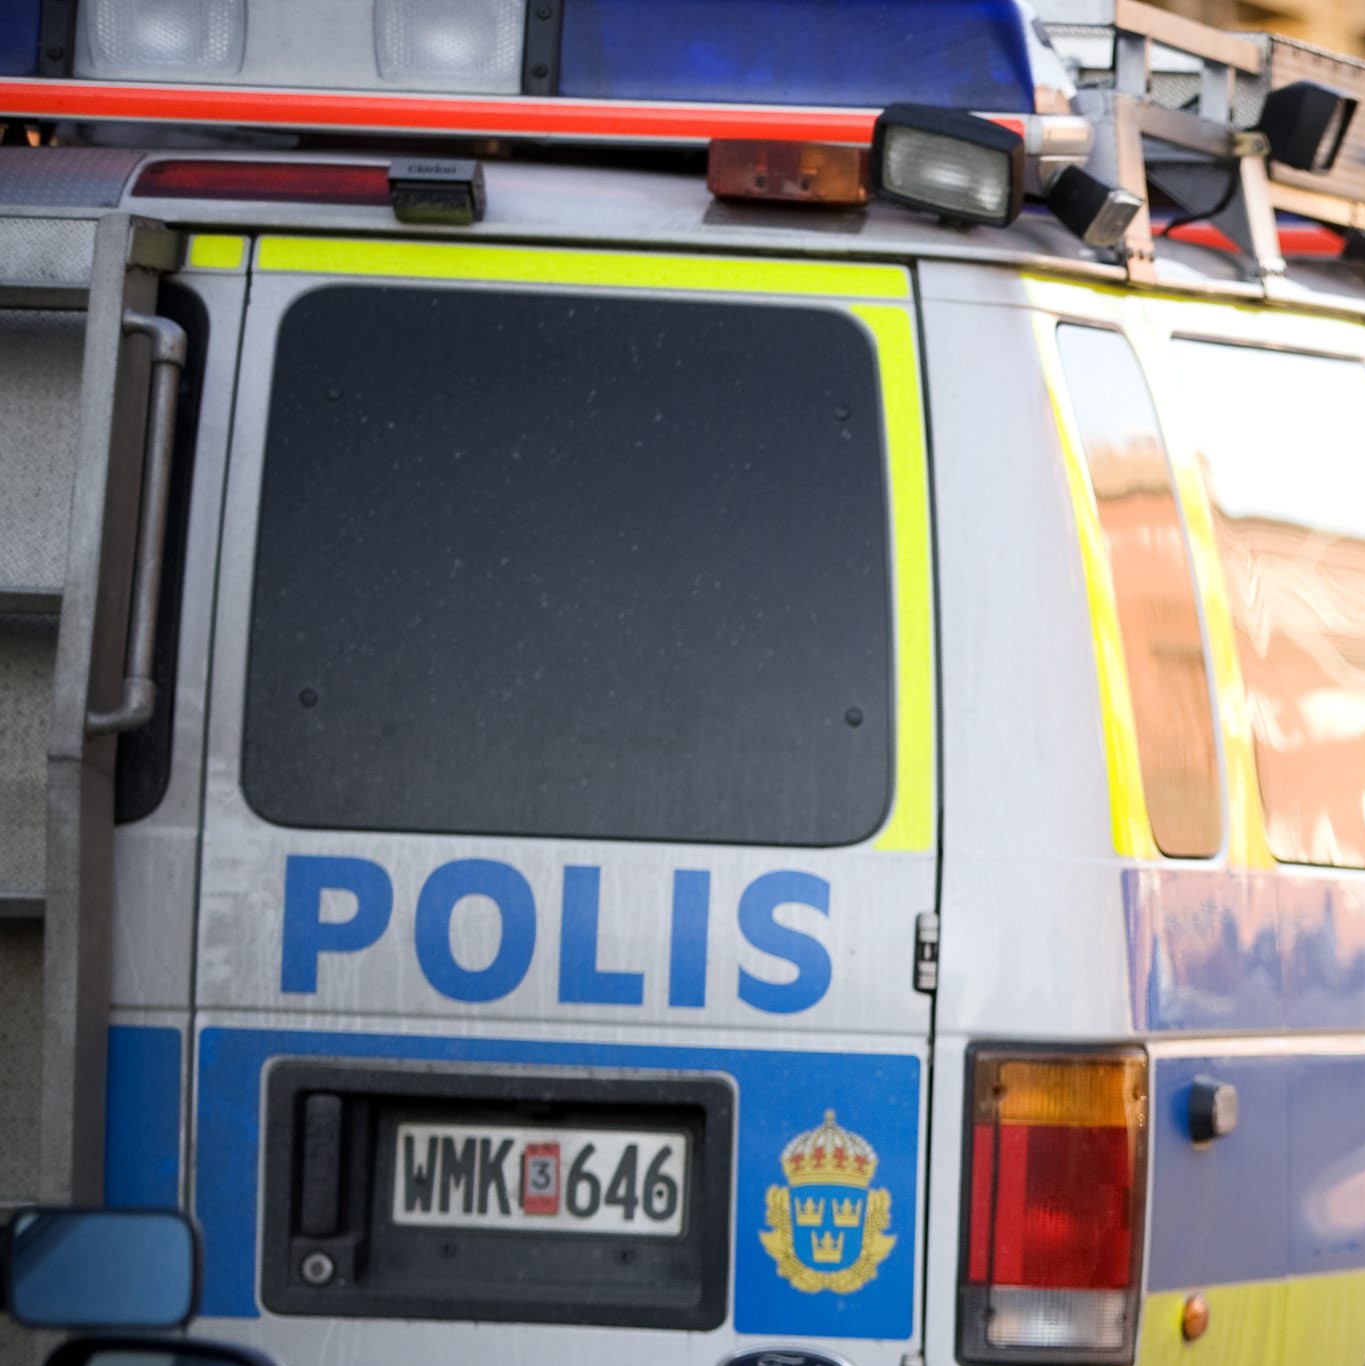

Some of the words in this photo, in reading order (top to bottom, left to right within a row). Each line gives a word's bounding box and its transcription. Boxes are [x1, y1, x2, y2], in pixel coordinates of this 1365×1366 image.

[280, 855, 833, 1014] POLIS
[403, 1133, 515, 1216] WMK
[566, 1142, 678, 1222] 646
